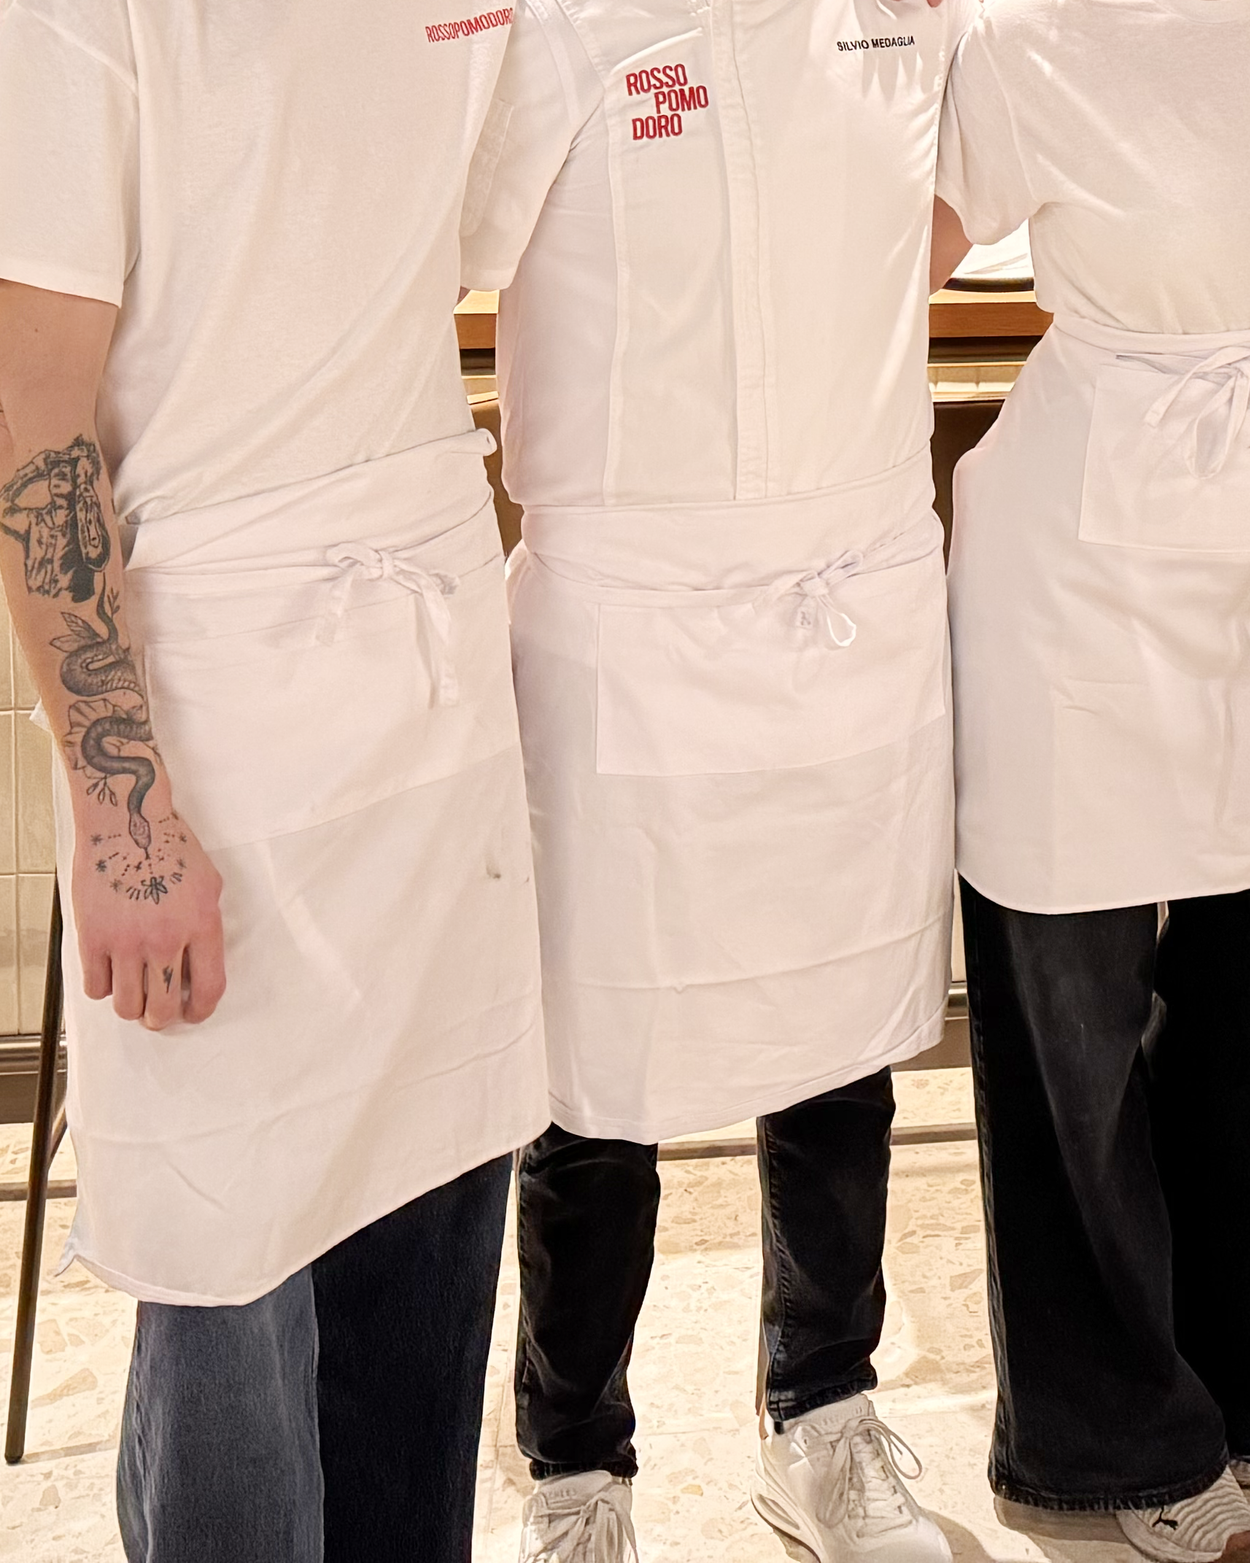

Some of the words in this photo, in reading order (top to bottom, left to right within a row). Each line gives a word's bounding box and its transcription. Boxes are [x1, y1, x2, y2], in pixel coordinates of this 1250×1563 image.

[836, 40, 870, 52] SILVIO
[871, 35, 915, 49] MEDAGLIA
[626, 63, 688, 96] ROSSO
[654, 85, 709, 114] POMO
[632, 113, 683, 141] DORO
